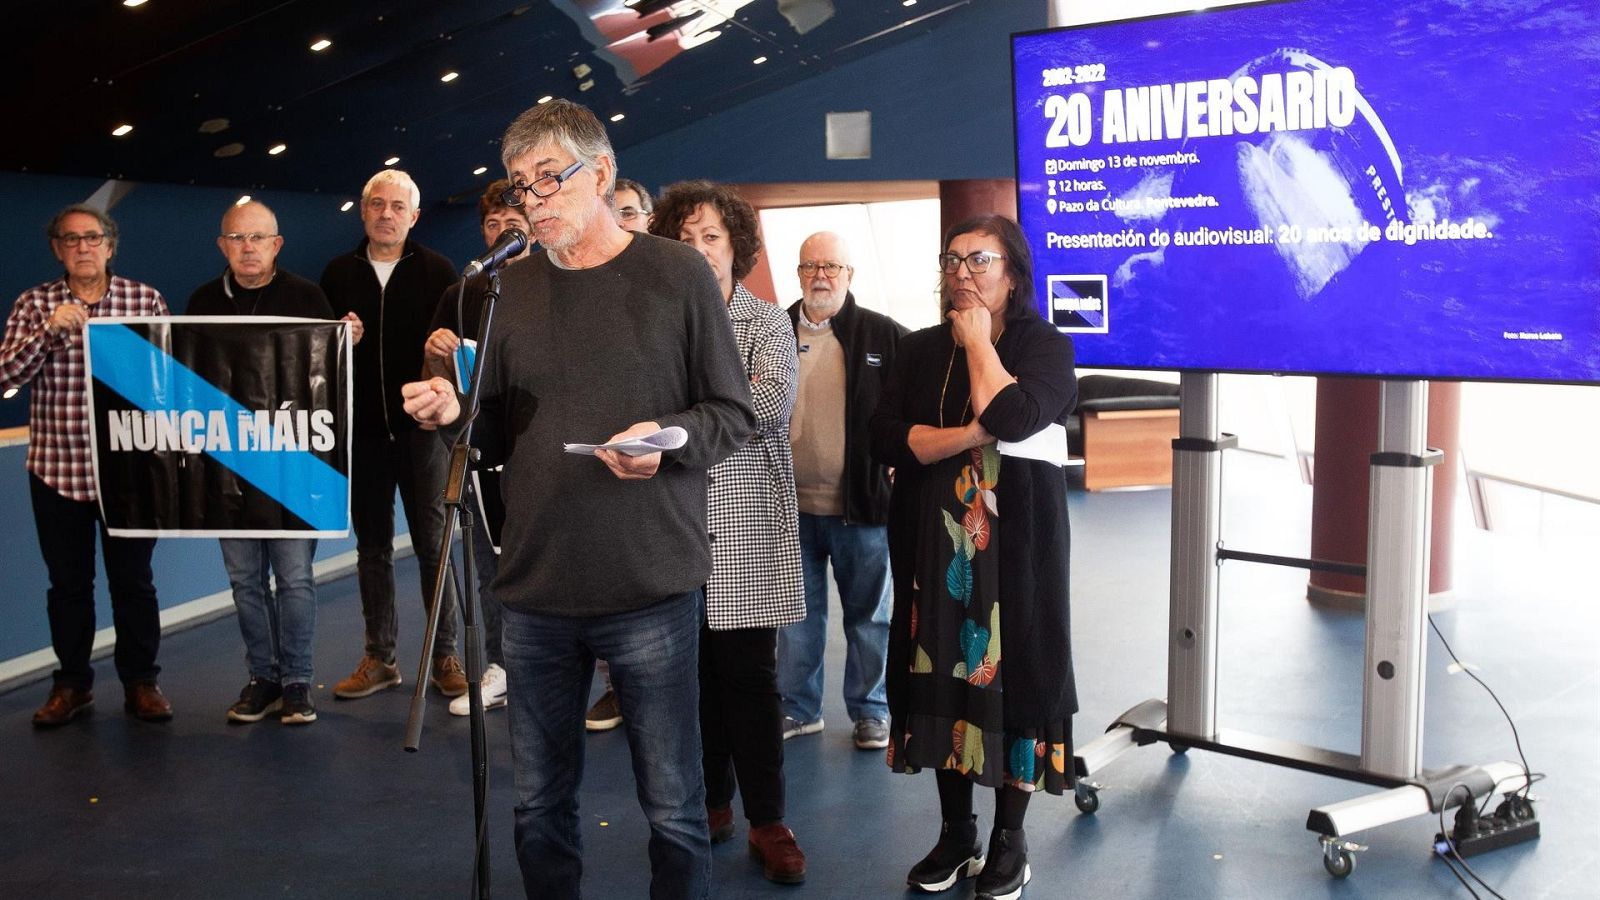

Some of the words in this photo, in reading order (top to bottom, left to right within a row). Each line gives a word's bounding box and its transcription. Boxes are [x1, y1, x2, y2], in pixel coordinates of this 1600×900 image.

[1044, 93, 1092, 148] 20
[1102, 66, 1356, 145] ANIVERSARIO
[1058, 157, 1105, 173] Domingo
[1108, 155, 1121, 168] 13
[1122, 154, 1137, 167] de
[1139, 151, 1200, 167] novembro.
[1059, 180, 1072, 192] 12
[1073, 178, 1106, 192] horas.
[1365, 164, 1399, 228] PREST
[1059, 199, 1084, 213] Pazo
[1085, 198, 1099, 212] da
[1145, 194, 1220, 209] Pontevedra.
[1046, 228, 1145, 249] Presentación
[1149, 227, 1170, 247] do
[1174, 224, 1274, 247] audiovisual:
[1278, 224, 1302, 244] 20
[1307, 226, 1352, 244] anos
[1357, 220, 1382, 242] de
[1385, 217, 1493, 246] dignidade.
[237, 400, 336, 453] MÁIS
